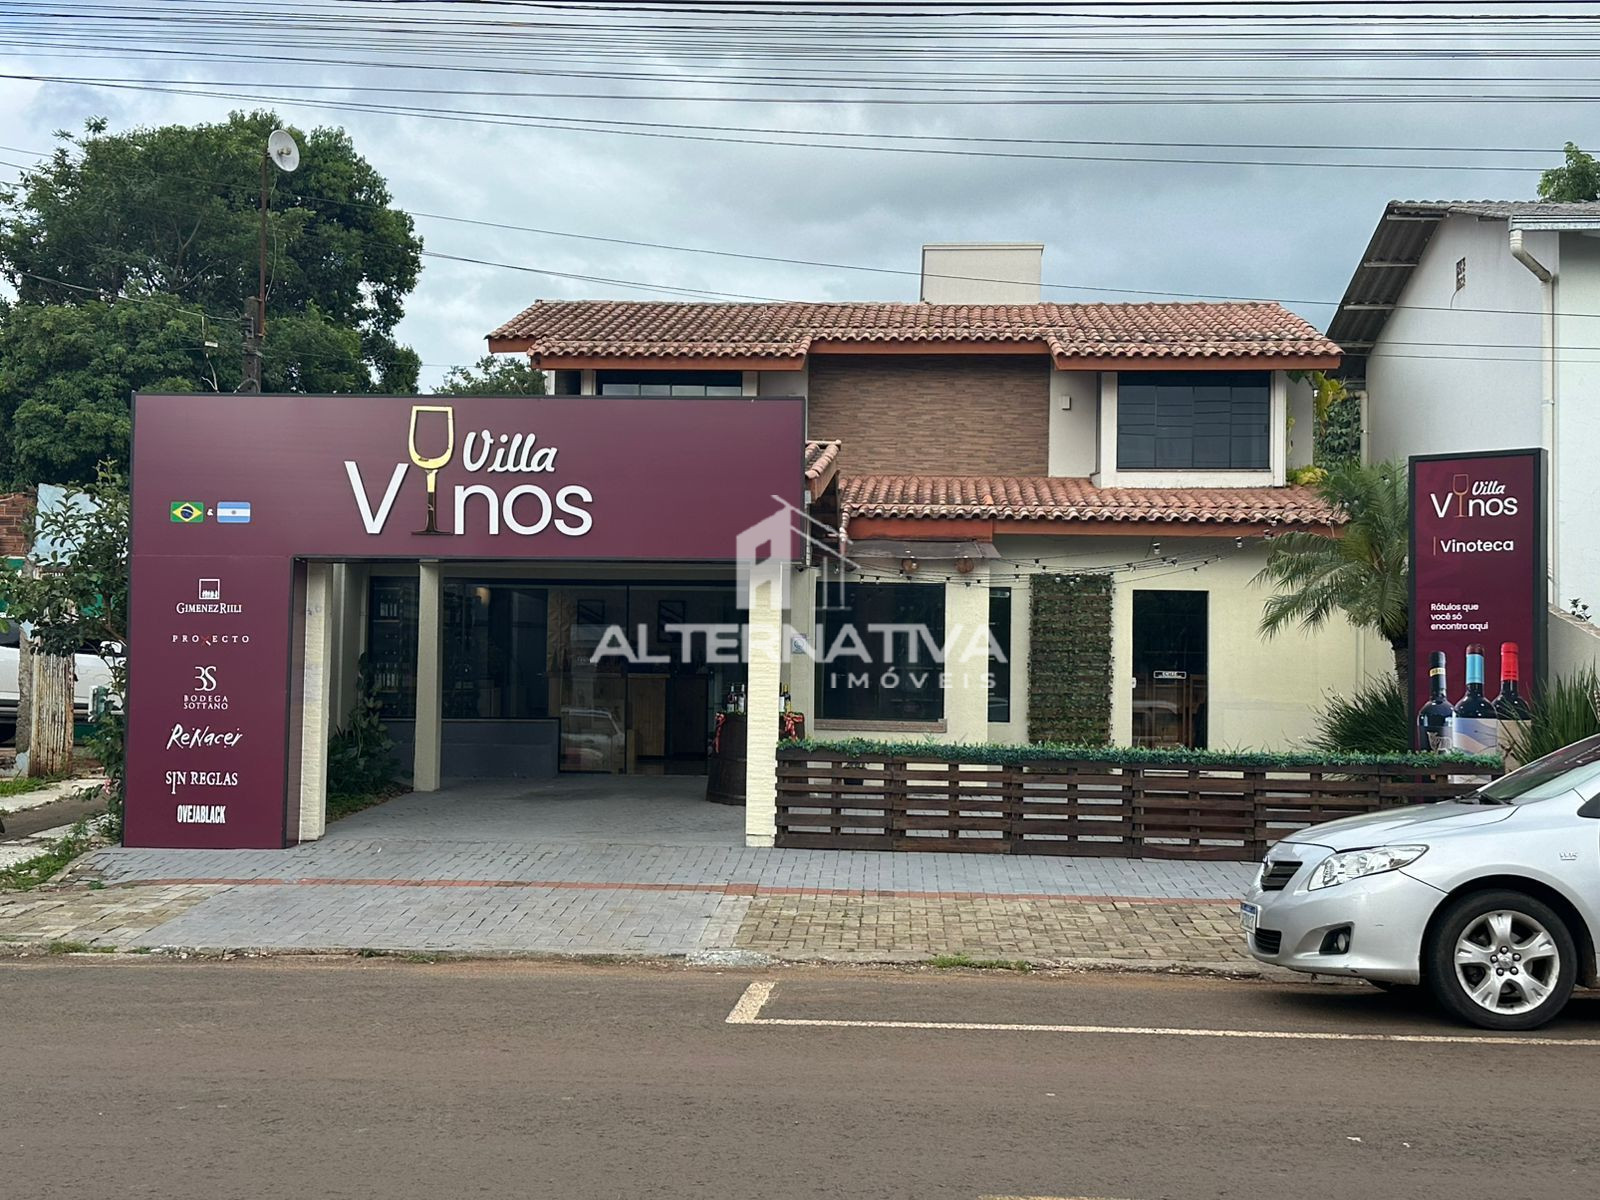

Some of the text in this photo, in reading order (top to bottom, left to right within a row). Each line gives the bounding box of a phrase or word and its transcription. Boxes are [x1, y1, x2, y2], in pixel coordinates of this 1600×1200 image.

[462, 429, 558, 473] Villa
[1471, 480, 1506, 496] Villa
[1440, 539, 1514, 553] Vinoteca
[1430, 602, 1480, 613] Rótulos que
[1430, 612, 1463, 621] você só
[1430, 621, 1489, 632] encontra aqui
[183, 694, 229, 703] BODEGA
[183, 702, 229, 710] SOTTANO
[165, 770, 238, 795] SIN REGLAS
[176, 804, 227, 824] OVEJABLACK
